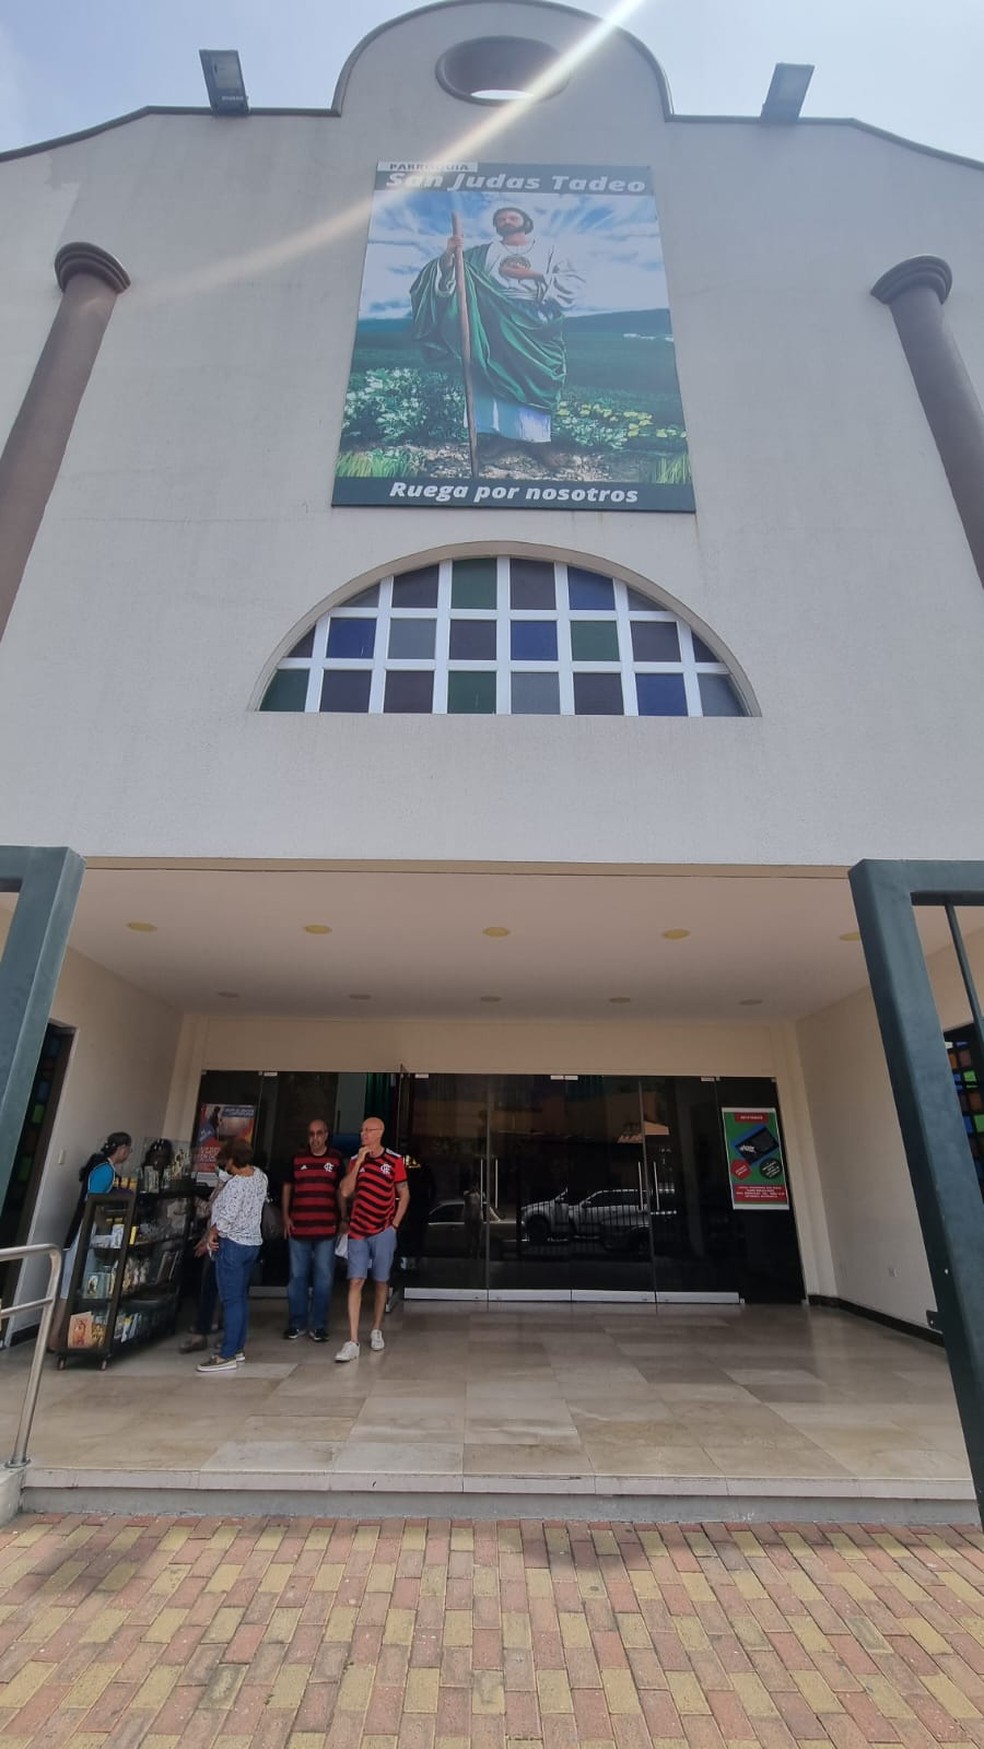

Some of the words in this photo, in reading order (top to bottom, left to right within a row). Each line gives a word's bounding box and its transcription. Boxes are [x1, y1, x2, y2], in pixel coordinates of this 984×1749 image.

[390, 163, 468, 171] PARRUIA
[386, 172, 443, 187] San
[447, 172, 541, 191] Judas
[552, 174, 645, 192] Tadeo
[390, 482, 468, 502] Ruega
[474, 485, 520, 502] por
[525, 486, 639, 503] nosotros
